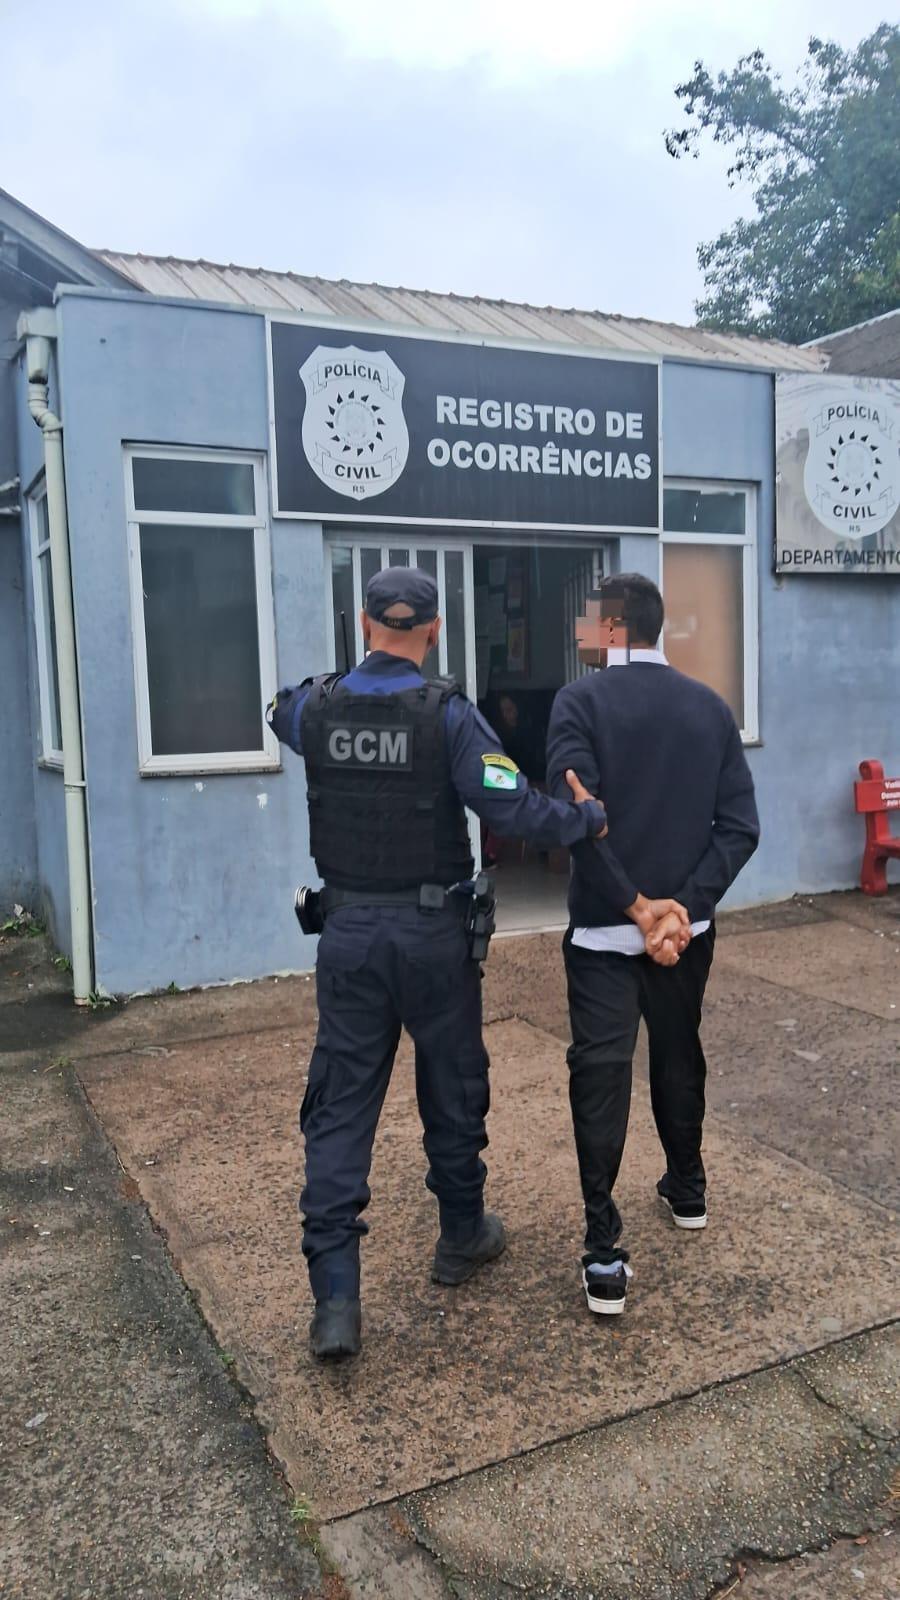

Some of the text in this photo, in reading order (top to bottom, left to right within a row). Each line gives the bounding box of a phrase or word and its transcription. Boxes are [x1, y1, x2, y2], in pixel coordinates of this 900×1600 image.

[324, 360, 382, 383] POLÍCIA
[436, 395, 644, 440] REGISTRO DE
[827, 402, 880, 423] POLÍCIA
[426, 438, 652, 480] OCORRÊNCIAS
[334, 464, 382, 480] CIVIL
[833, 504, 877, 520] CIVIL
[328, 728, 408, 764] GCM
